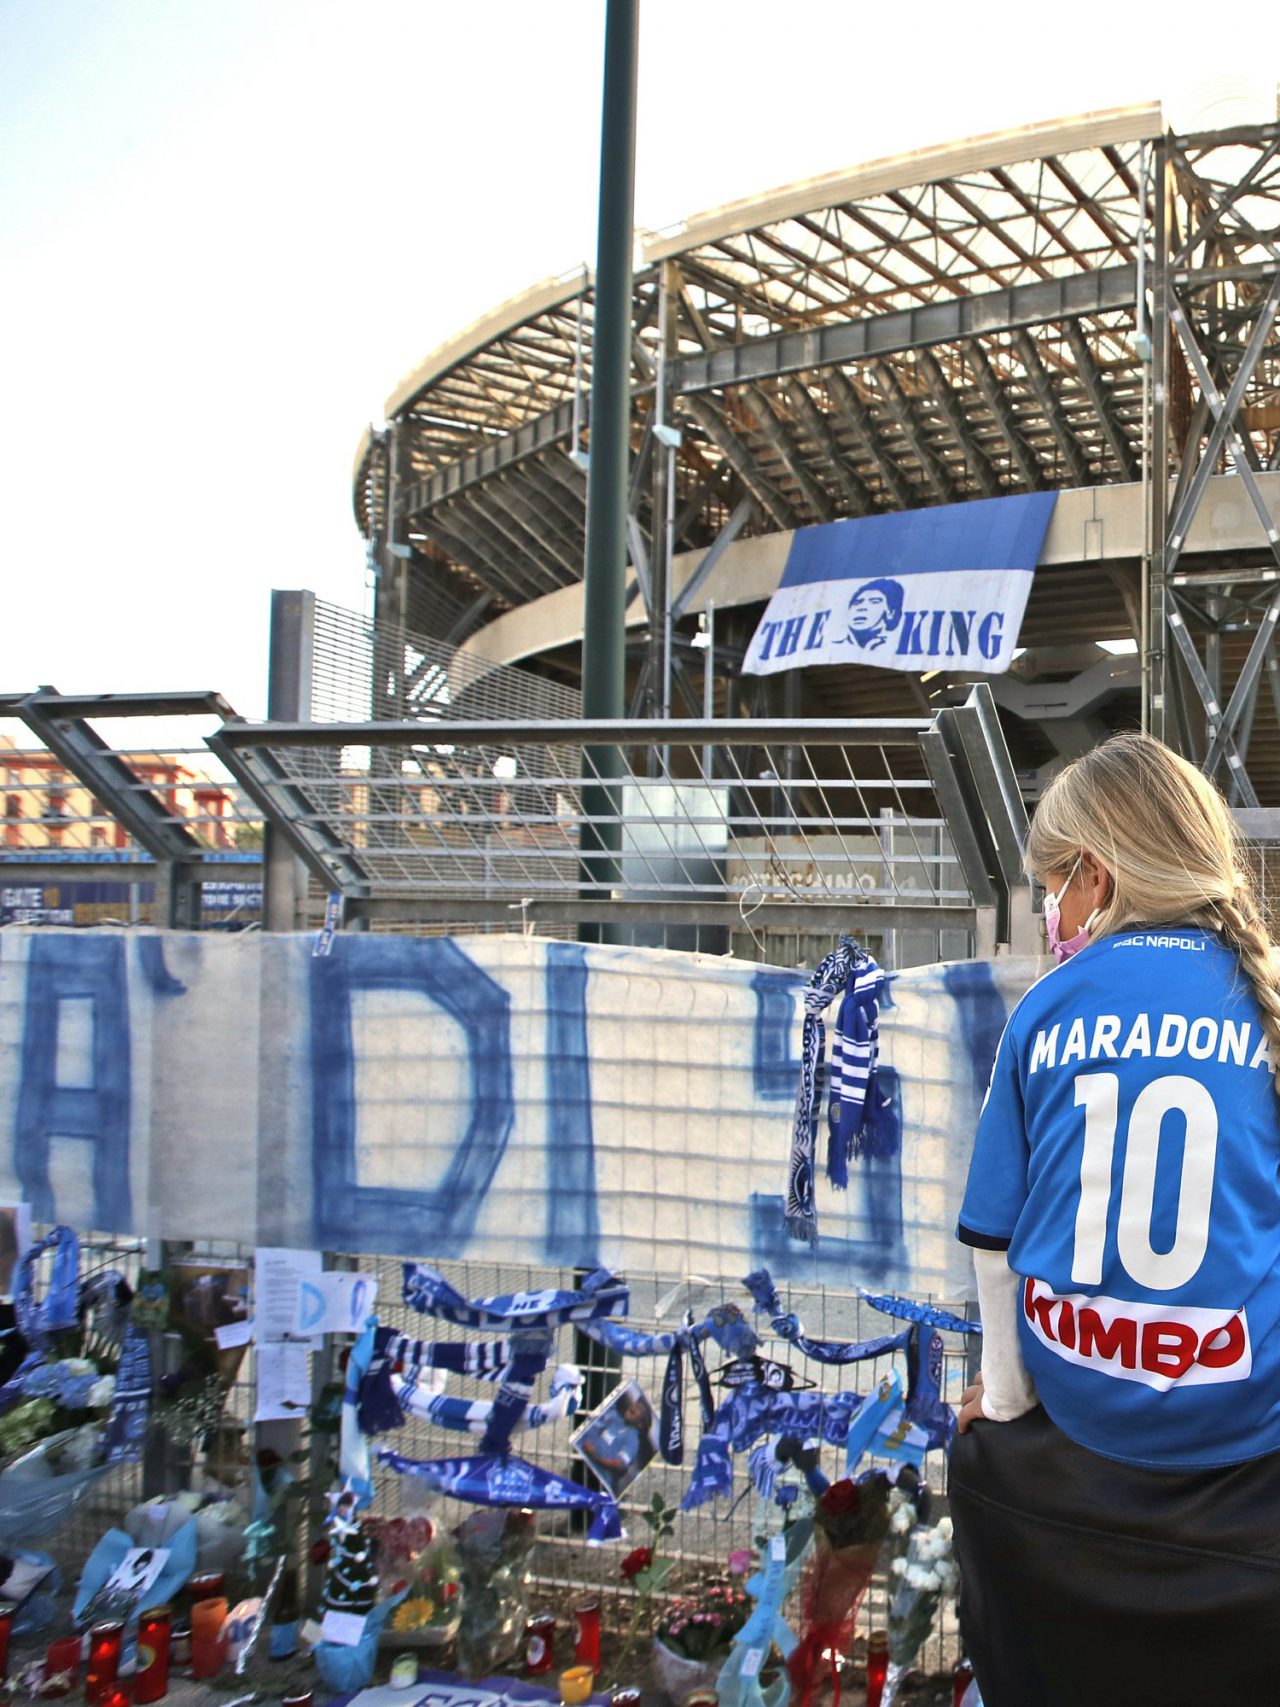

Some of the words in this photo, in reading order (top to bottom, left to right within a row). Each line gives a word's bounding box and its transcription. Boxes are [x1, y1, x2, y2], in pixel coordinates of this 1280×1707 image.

[759, 609, 832, 661] THE
[895, 610, 1005, 660] KING
[1146, 935, 1206, 952] NAPOLI
[1071, 1072, 1219, 1291] 10
[1025, 1276, 1246, 1380] KIMBO
